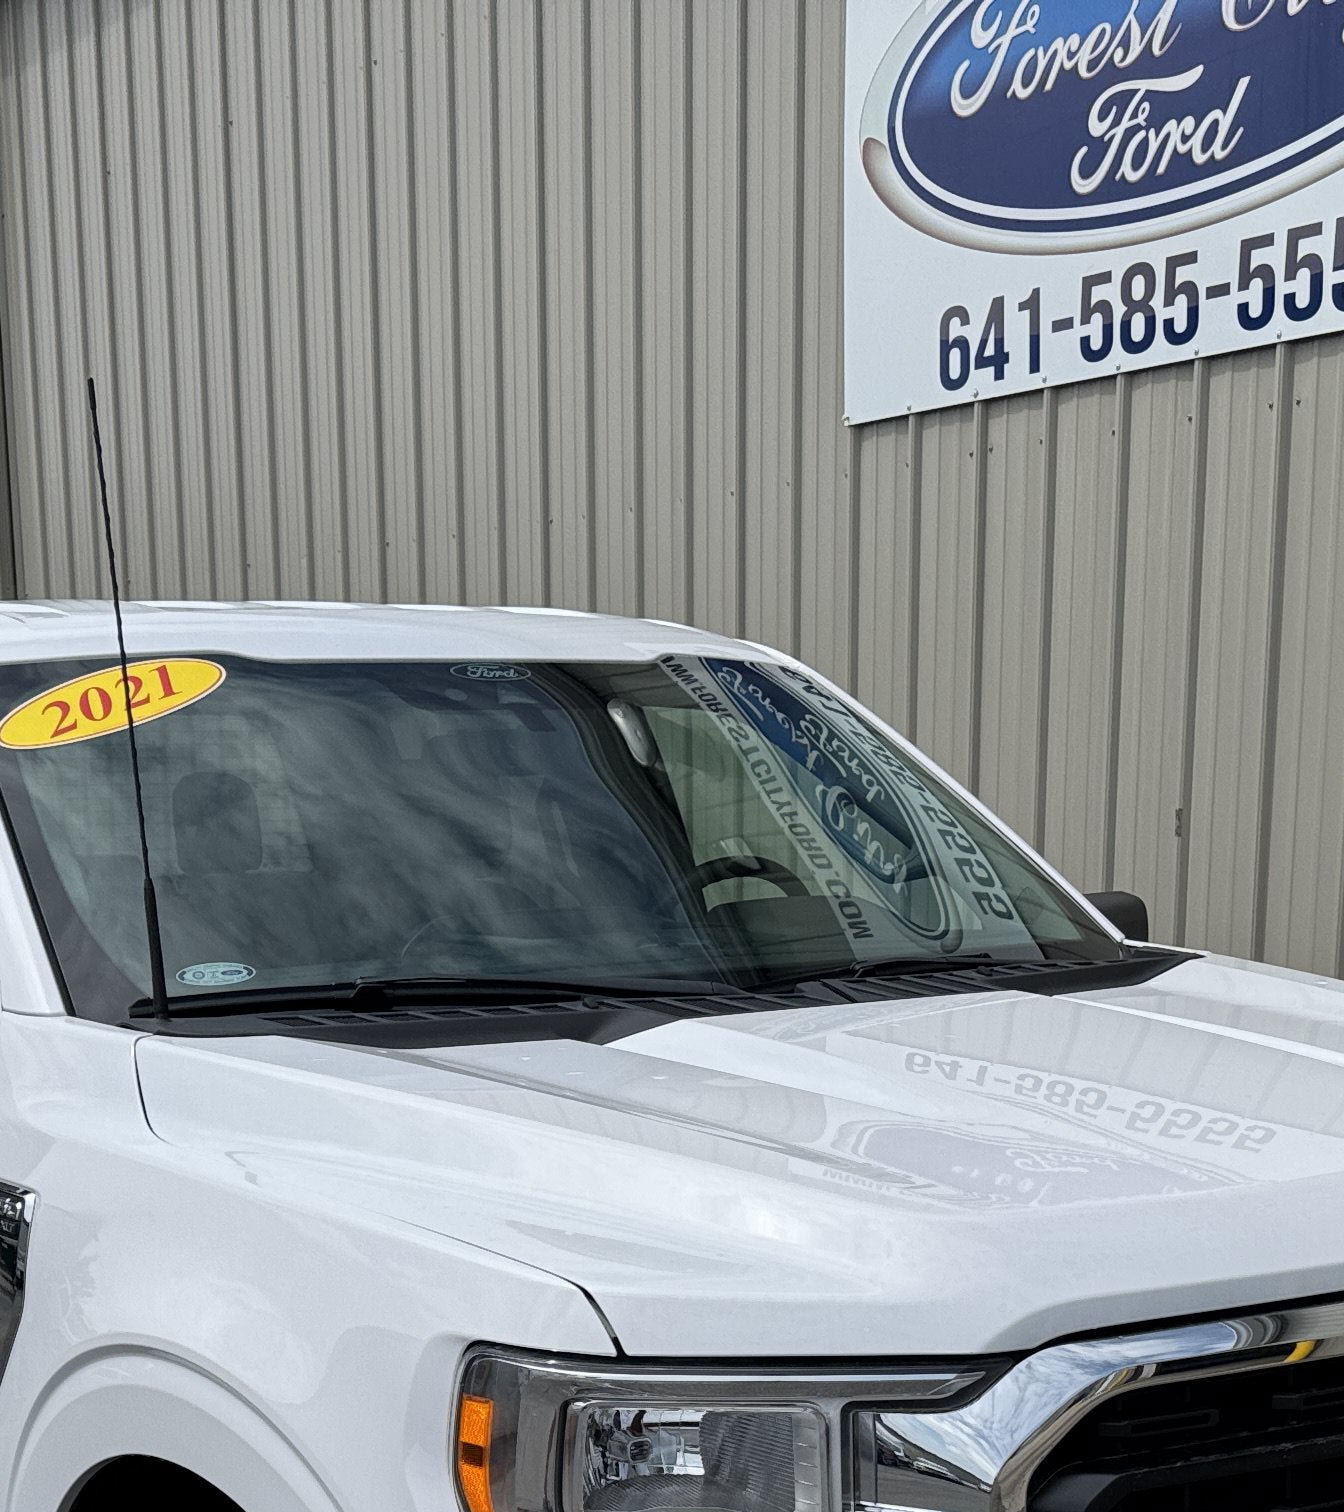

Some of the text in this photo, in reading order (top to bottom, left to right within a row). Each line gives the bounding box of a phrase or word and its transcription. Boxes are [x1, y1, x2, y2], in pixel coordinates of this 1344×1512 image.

[1070, 64, 1251, 196] Ford
[41, 664, 183, 739] 2021
[467, 665, 518, 678] Ford
